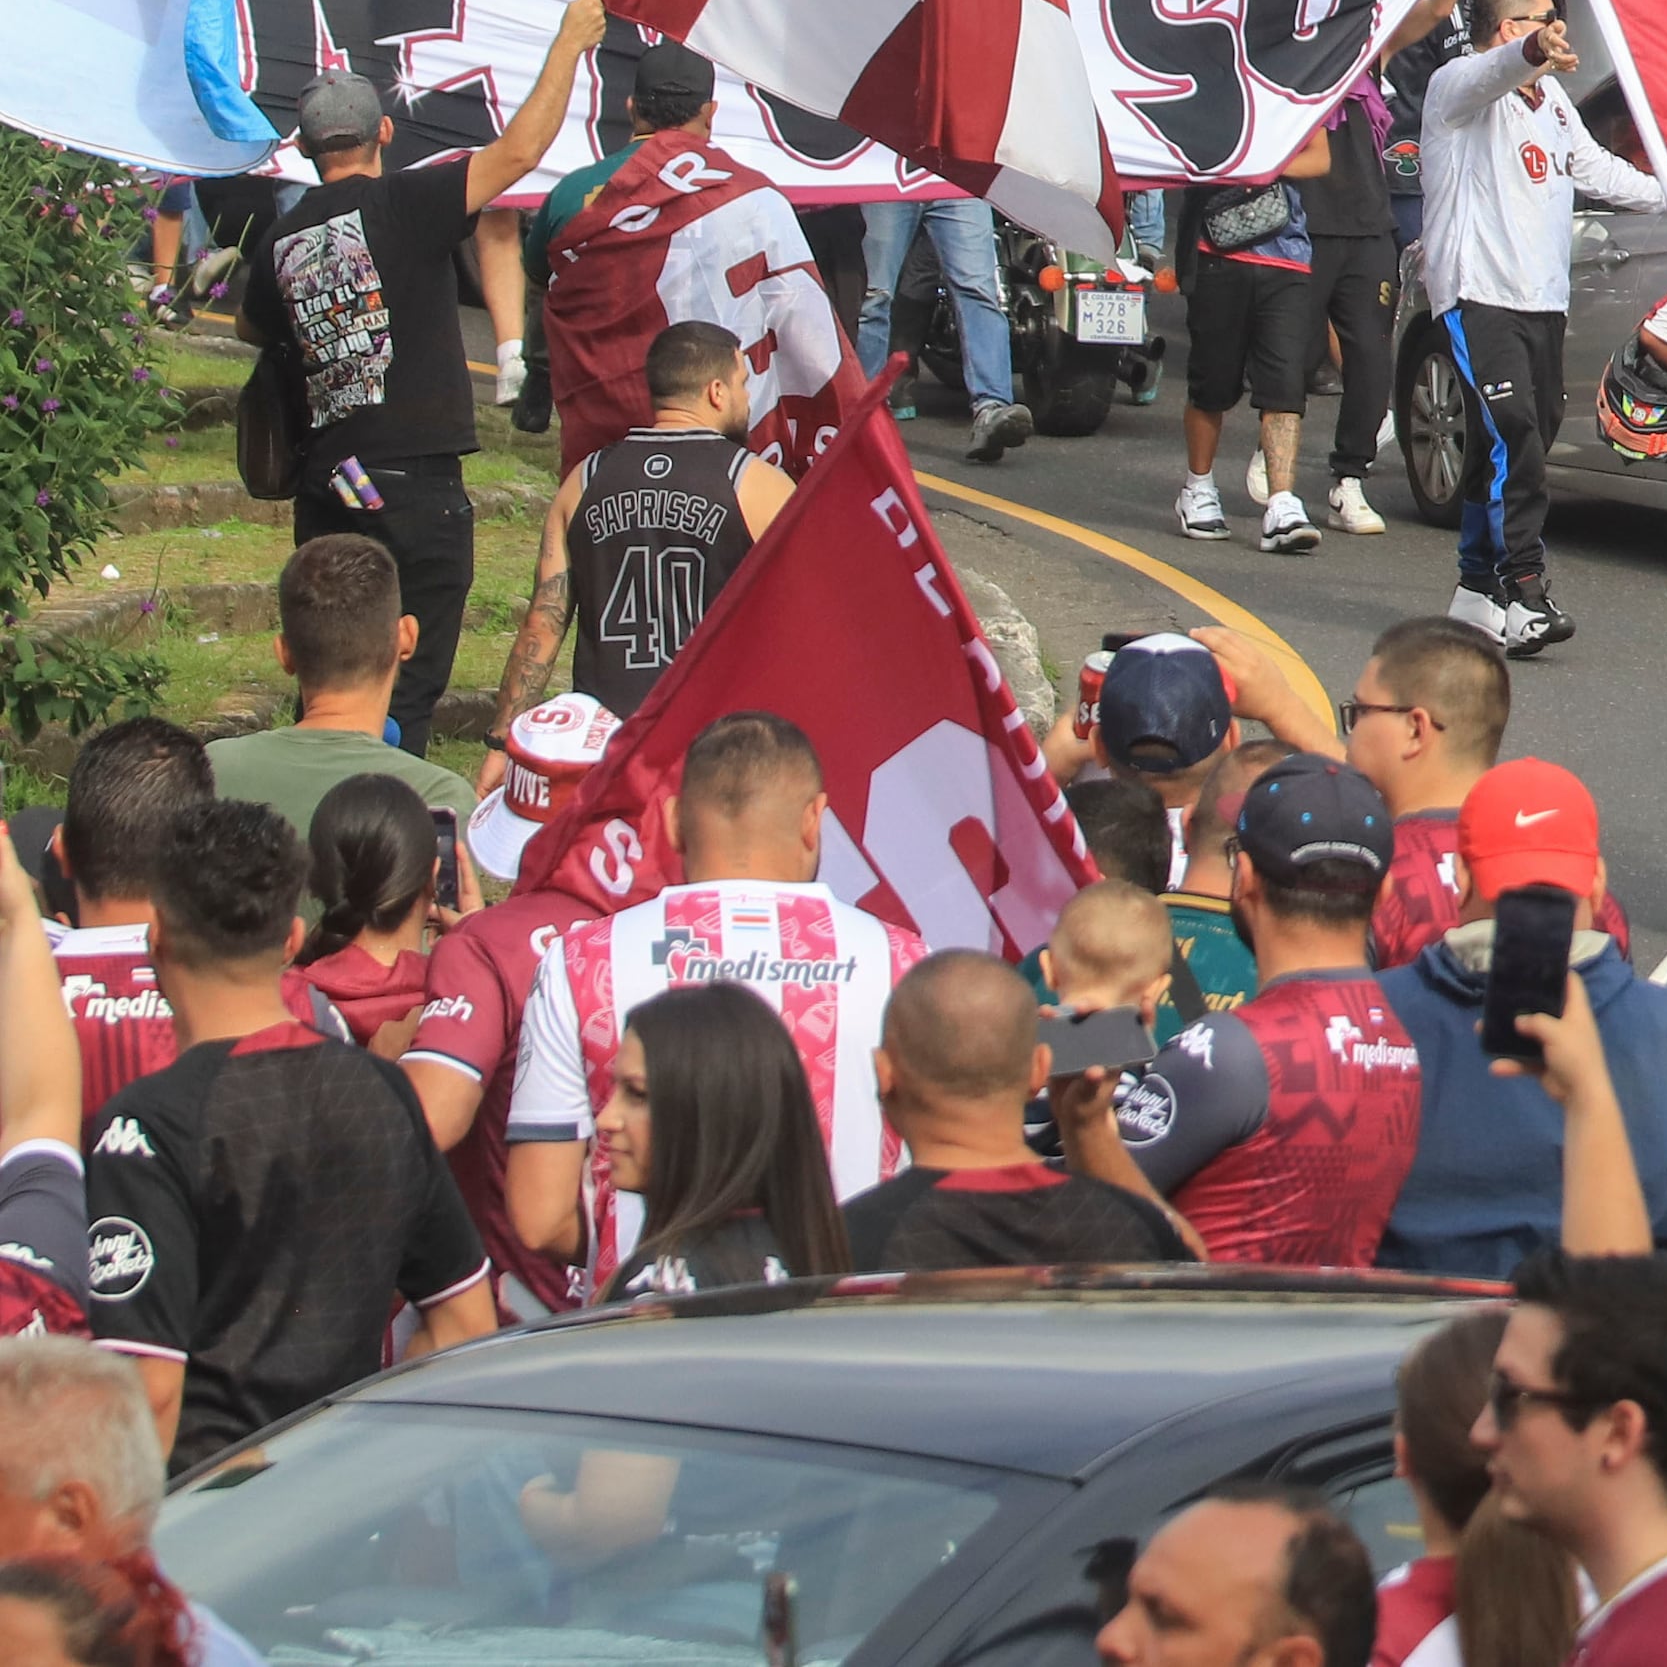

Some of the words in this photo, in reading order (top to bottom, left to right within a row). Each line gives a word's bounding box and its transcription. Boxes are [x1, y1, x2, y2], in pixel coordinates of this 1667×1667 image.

[1083, 312, 1093, 324] M
[1095, 319, 1126, 334] 326
[1096, 302, 1126, 317] 278
[585, 489, 728, 545] SAPRISSA
[600, 545, 706, 670] 40
[685, 950, 858, 990] medismart
[85, 989, 174, 1025] medis
